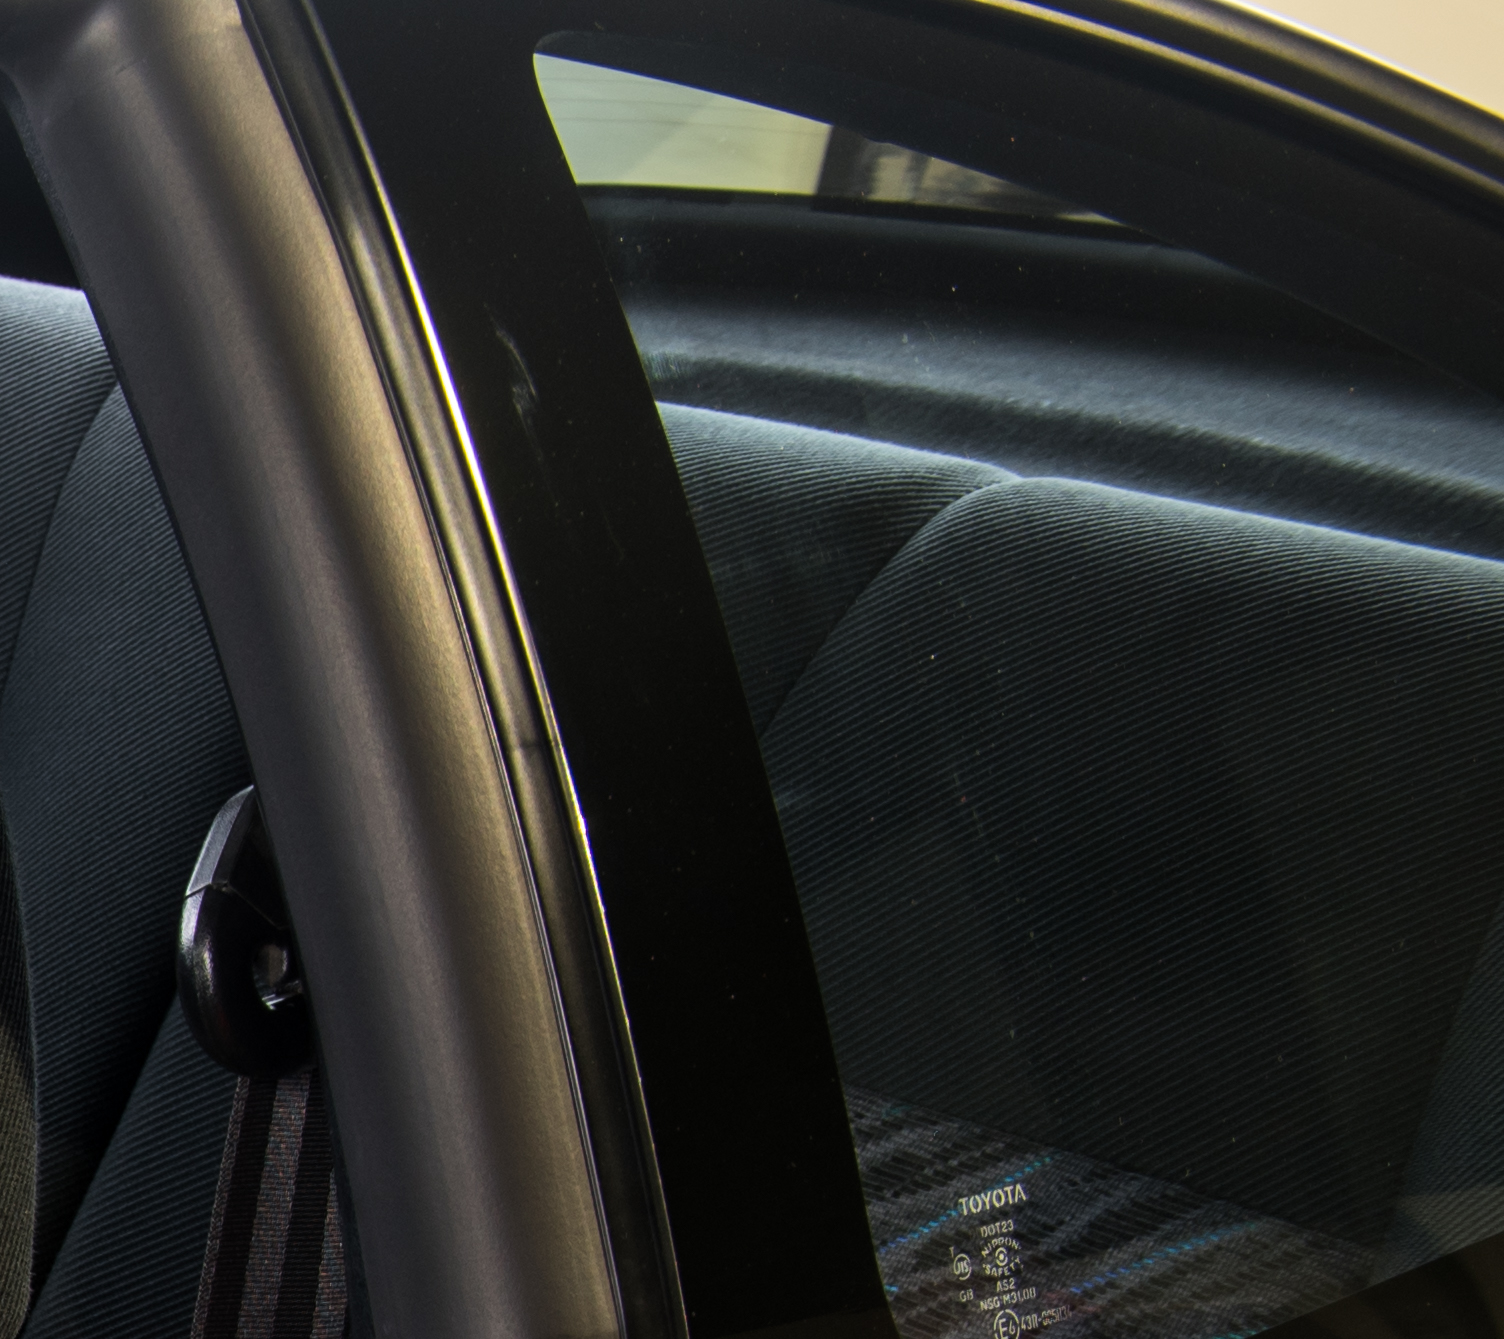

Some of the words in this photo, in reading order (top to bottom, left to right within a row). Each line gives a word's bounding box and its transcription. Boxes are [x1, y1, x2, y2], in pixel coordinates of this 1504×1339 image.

[958, 1184, 1027, 1216] TOYOTA
[980, 1219, 1014, 1238] DOT23
[996, 1278, 1016, 1293] AS2
[980, 1296, 1000, 1311] NSG
